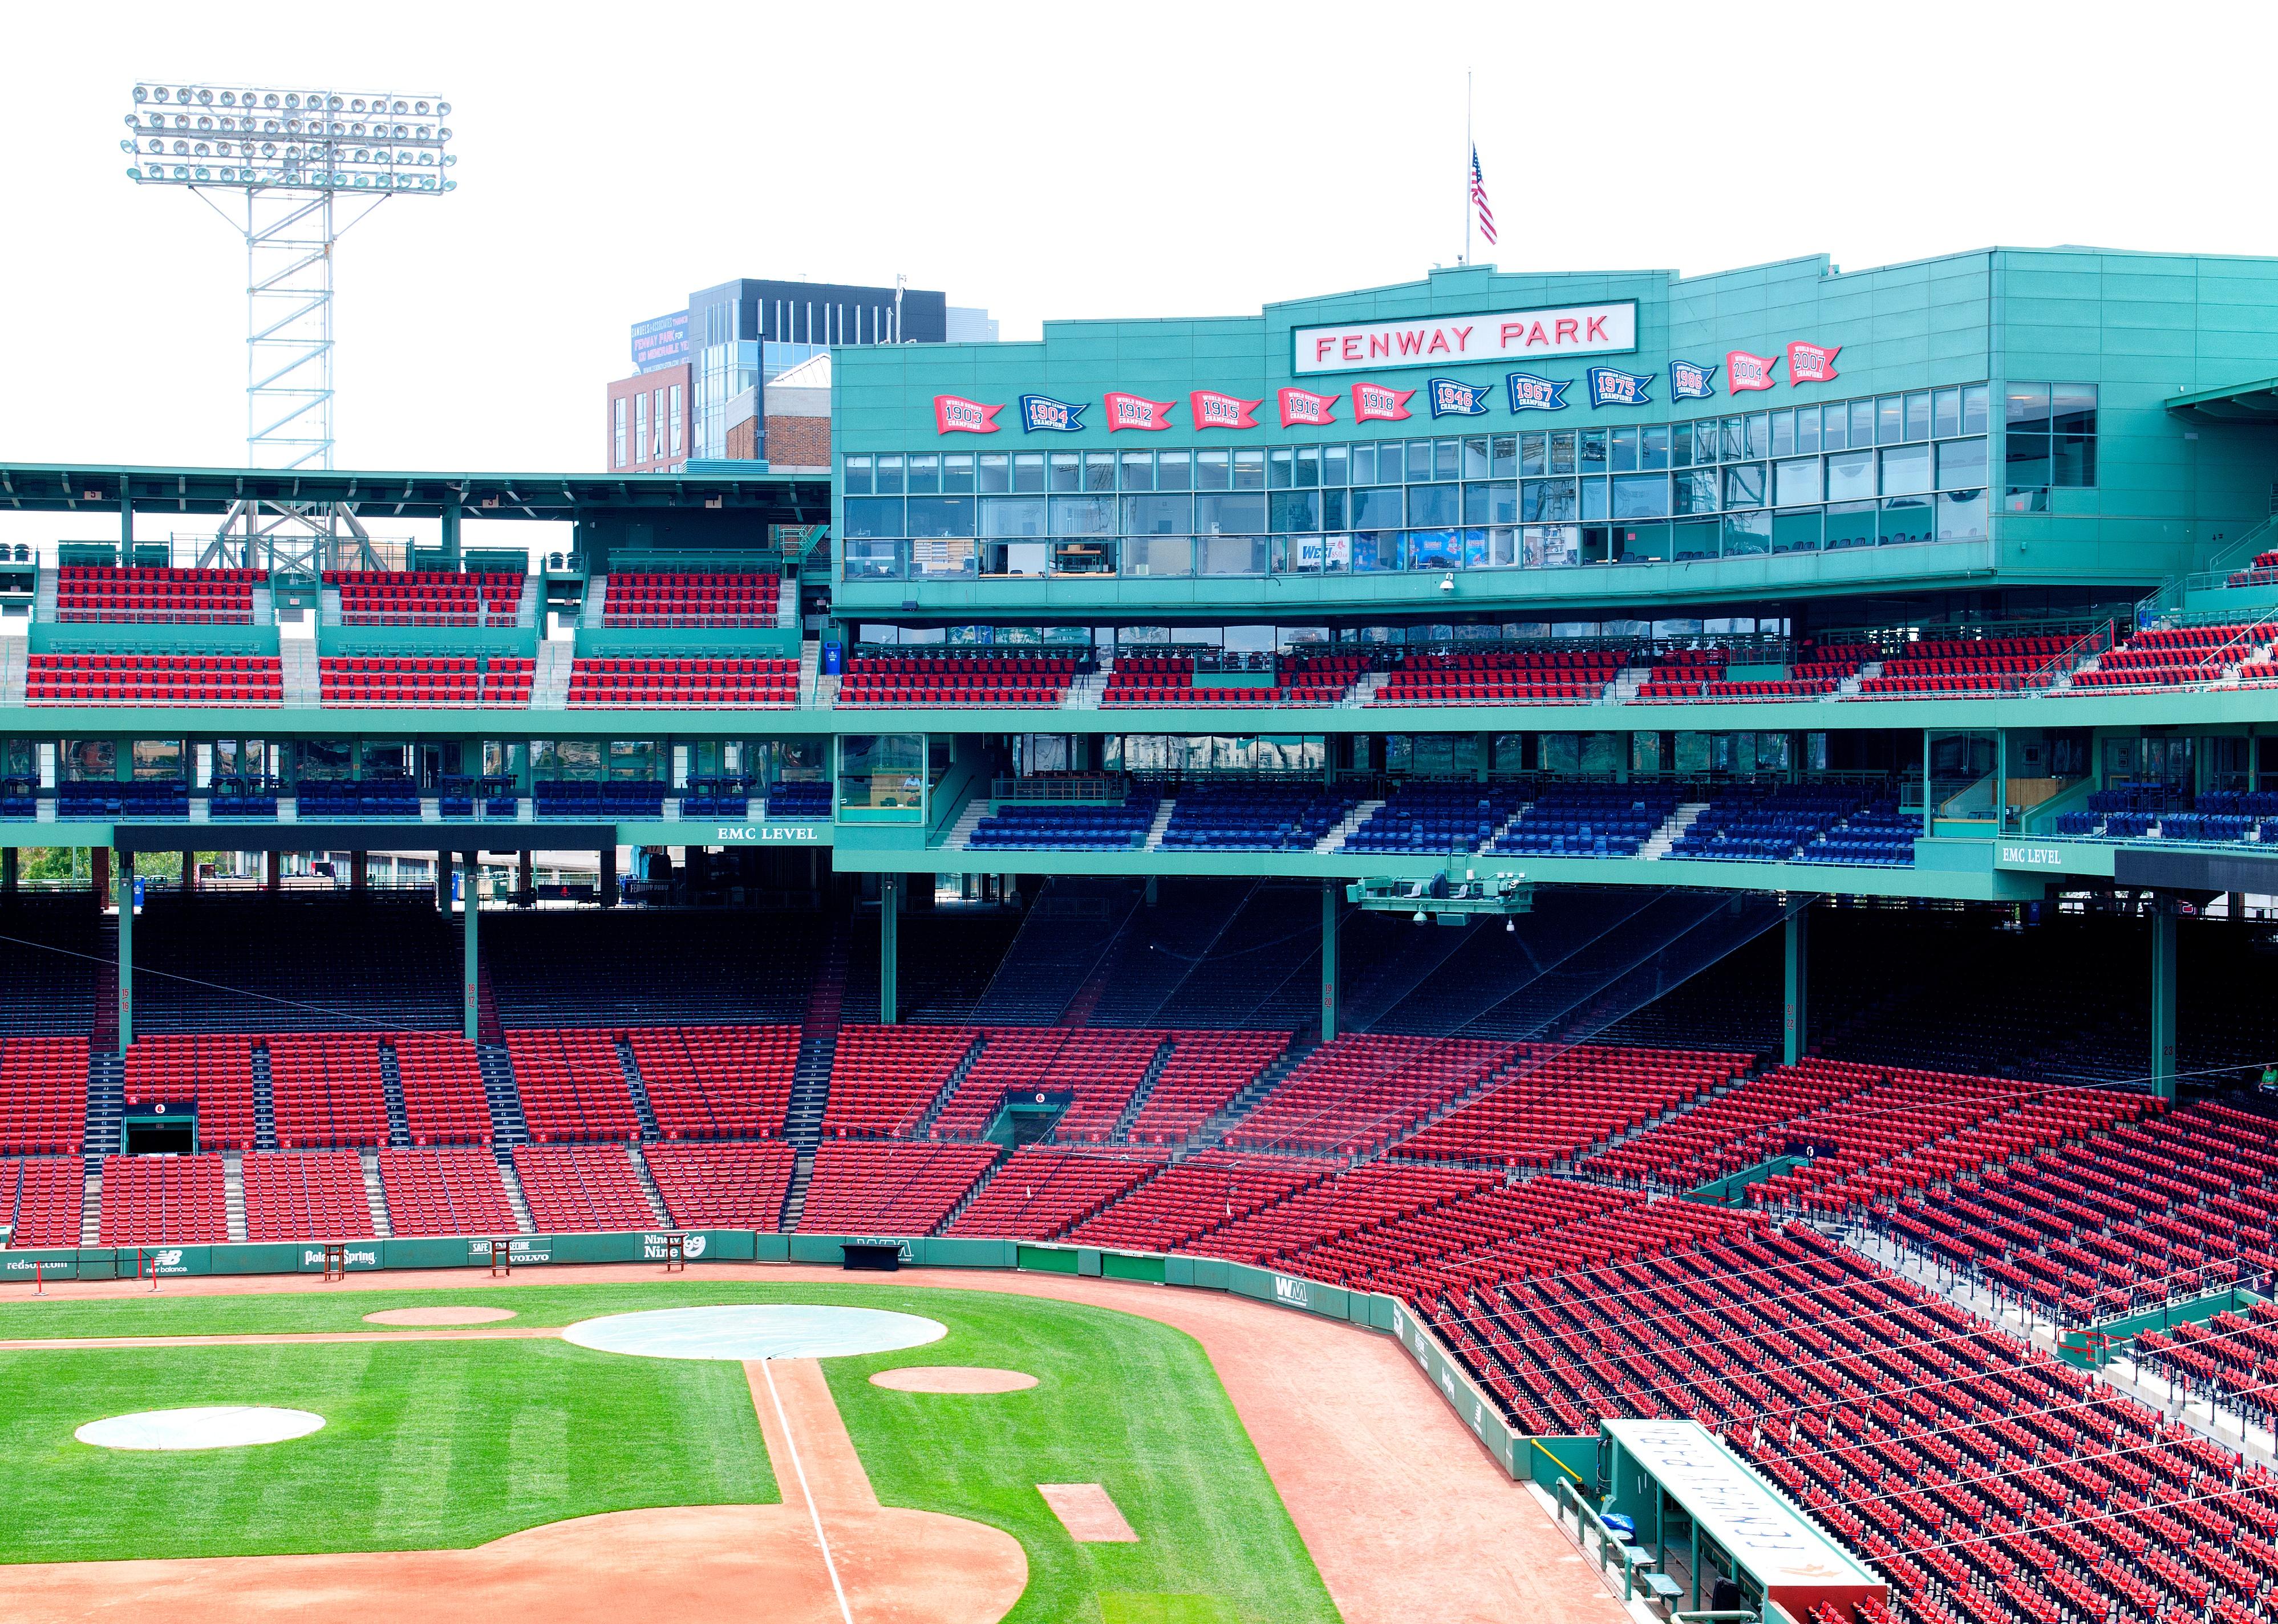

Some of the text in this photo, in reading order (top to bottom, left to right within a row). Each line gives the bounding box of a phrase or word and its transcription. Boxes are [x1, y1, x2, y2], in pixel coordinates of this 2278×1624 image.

[634, 334, 658, 351] FENWAY
[659, 330, 675, 344] PARK
[1316, 315, 1608, 362] FENWAY PARK
[1793, 352, 1825, 372] 2007
[1733, 362, 1762, 380] 2004
[1797, 370, 1822, 379] CHAMPIONS
[1676, 371, 1703, 389] 1986
[1736, 378, 1760, 387] CHAMPIONS
[1598, 376, 1635, 396] 1975
[1438, 388, 1473, 407] 1946
[1517, 383, 1553, 402] 1967
[1600, 393, 1632, 402] CHAMPIONS
[965, 403, 982, 411] SERIES
[1052, 402, 1067, 411] LEAGUE
[1135, 400, 1153, 409] SERIES
[1222, 397, 1239, 407] SERIES
[1289, 398, 1319, 416] 1916
[1363, 393, 1395, 411] 1918
[1519, 399, 1550, 408] CHAMPIONS
[1117, 403, 1152, 421] 1912
[1204, 400, 1239, 420] 1915
[1364, 408, 1393, 417] CHAMPIONS
[1441, 404, 1470, 412] CHAMPIONS
[945, 405, 983, 424] 1903
[1030, 405, 1068, 424] 1904
[1205, 415, 1238, 425] CHAMPIONS
[1290, 412, 1319, 422] CHAMPIONS
[948, 419, 980, 429] CHAMPIONS
[1033, 419, 1066, 428] CHAMPIONS
[1118, 417, 1151, 427] CHAMPIONS
[1303, 546, 1332, 559] WEI
[718, 827, 818, 839] EMC LEVEL
[2003, 847, 2061, 864] EMC LEVEL
[122, 988, 129, 997] 15
[1787, 1004, 1794, 1013] 21
[1787, 1019, 1794, 1028] 22
[2164, 1046, 2174, 1055] 23
[472, 1243, 489, 1252] SAFE
[509, 1241, 530, 1251] SECURE
[644, 1246, 679, 1257] Nine
[343, 1249, 376, 1264] Spring
